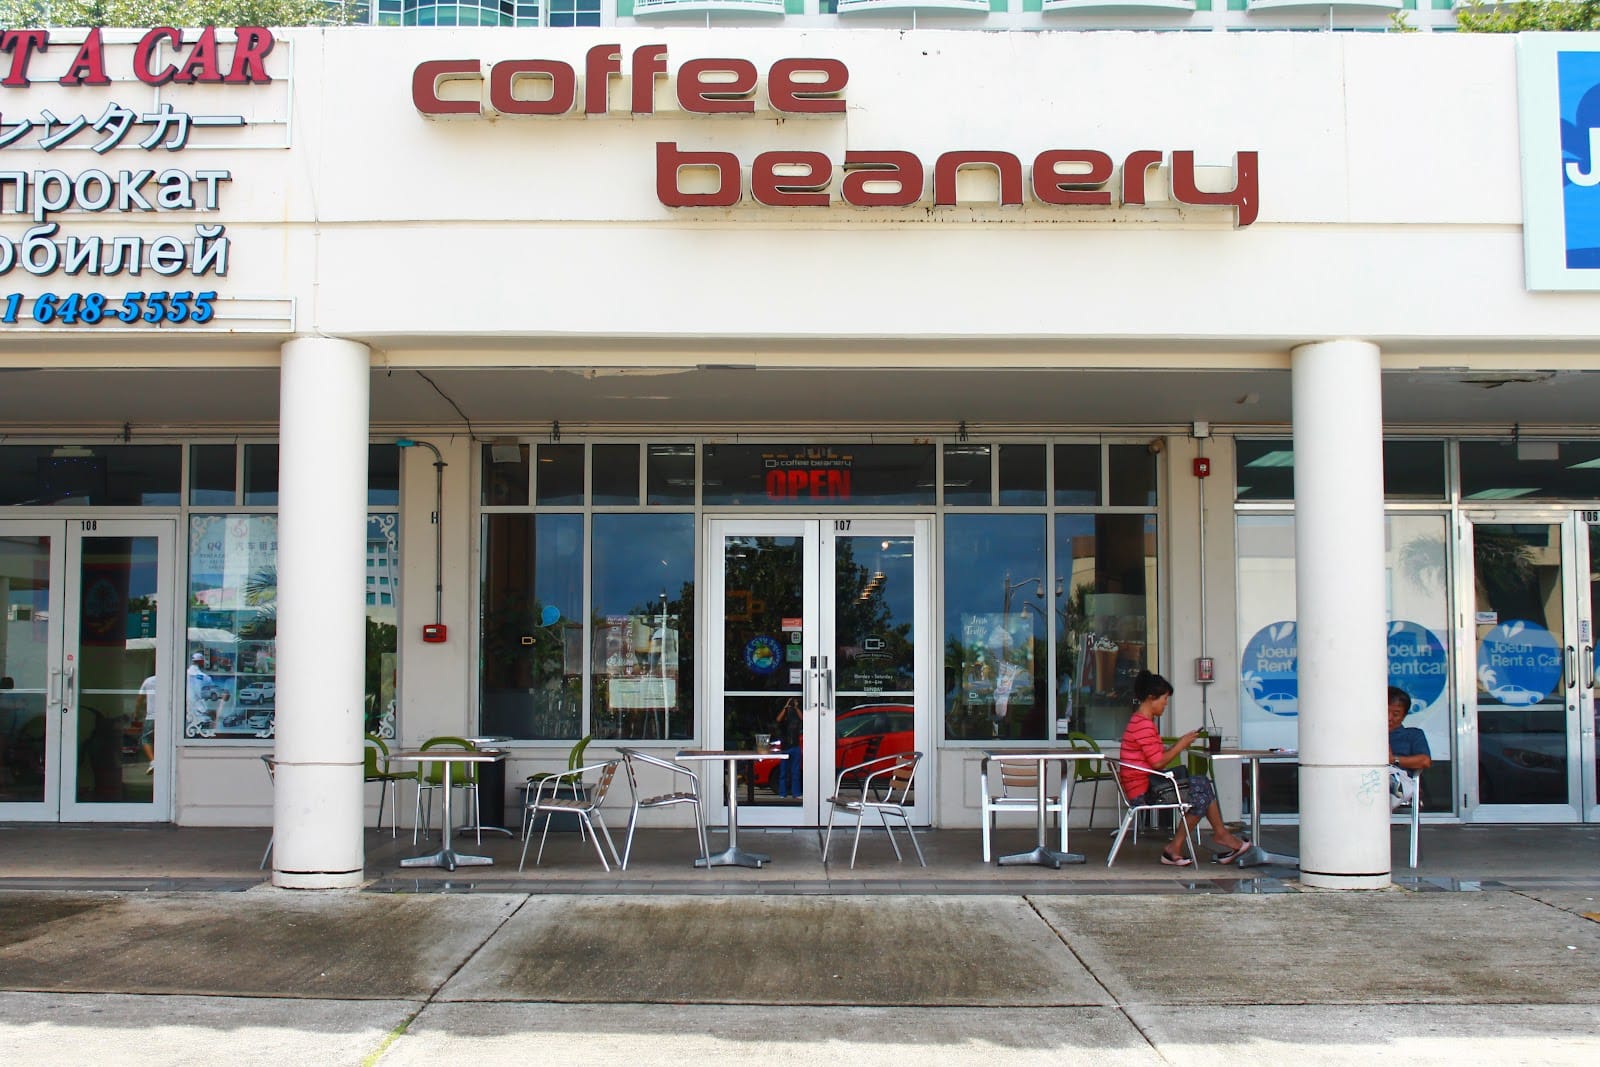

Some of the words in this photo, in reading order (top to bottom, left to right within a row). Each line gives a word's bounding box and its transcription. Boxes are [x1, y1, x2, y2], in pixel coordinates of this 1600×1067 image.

[60, 26, 111, 86] A
[133, 25, 275, 86] CAR
[411, 43, 850, 116] coffee
[655, 141, 1260, 227] beanery
[0, 168, 232, 222] прокат
[32, 291, 217, 325] 648-5555
[780, 459, 809, 467] coffee
[811, 459, 852, 468] beanery
[764, 469, 852, 501] OPEN
[81, 520, 97, 531] 108
[834, 520, 851, 531] 107
[1388, 644, 1432, 657] oeun
[1491, 641, 1533, 654] Joeun
[1257, 660, 1293, 673] Rent
[1388, 658, 1447, 675] entcar
[1491, 654, 1523, 667] Rent
[1526, 657, 1535, 667] a
[1537, 654, 1563, 667] Car
